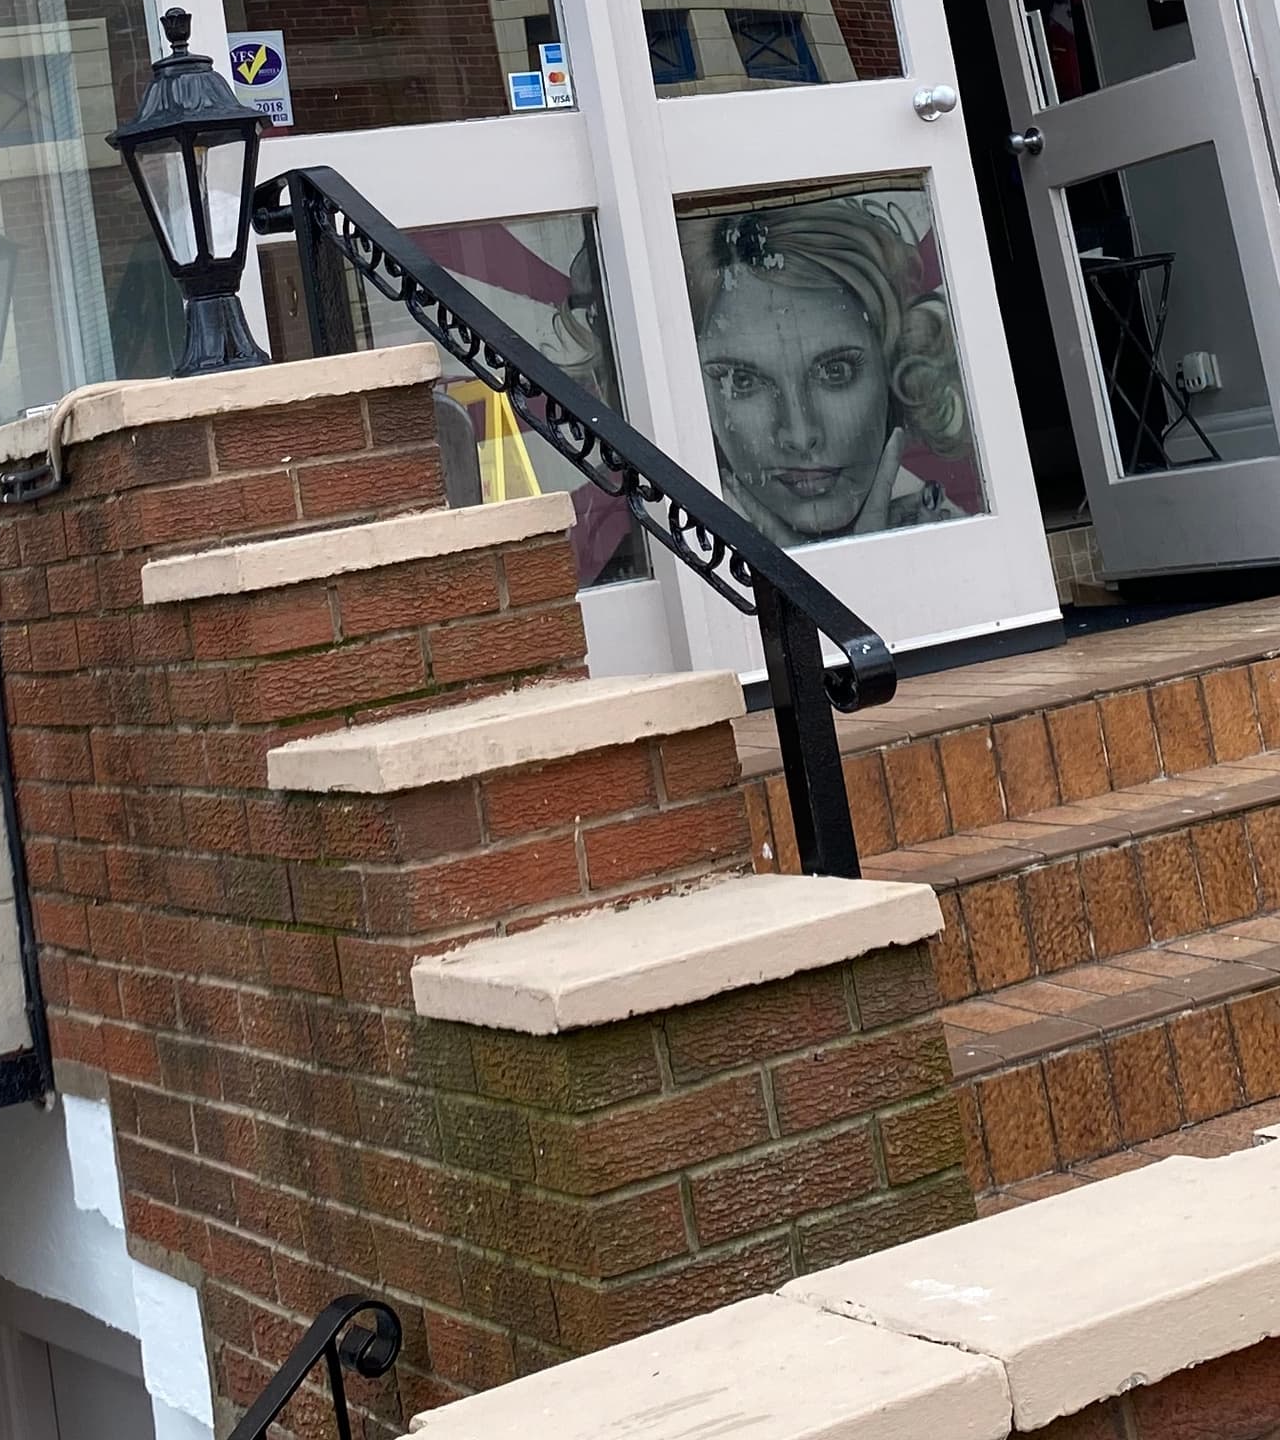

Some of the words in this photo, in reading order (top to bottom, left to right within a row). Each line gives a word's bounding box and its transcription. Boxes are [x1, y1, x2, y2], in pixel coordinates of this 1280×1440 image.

[231, 50, 255, 63] YES
[551, 94, 571, 104] VISA
[256, 102, 284, 114] 2018
